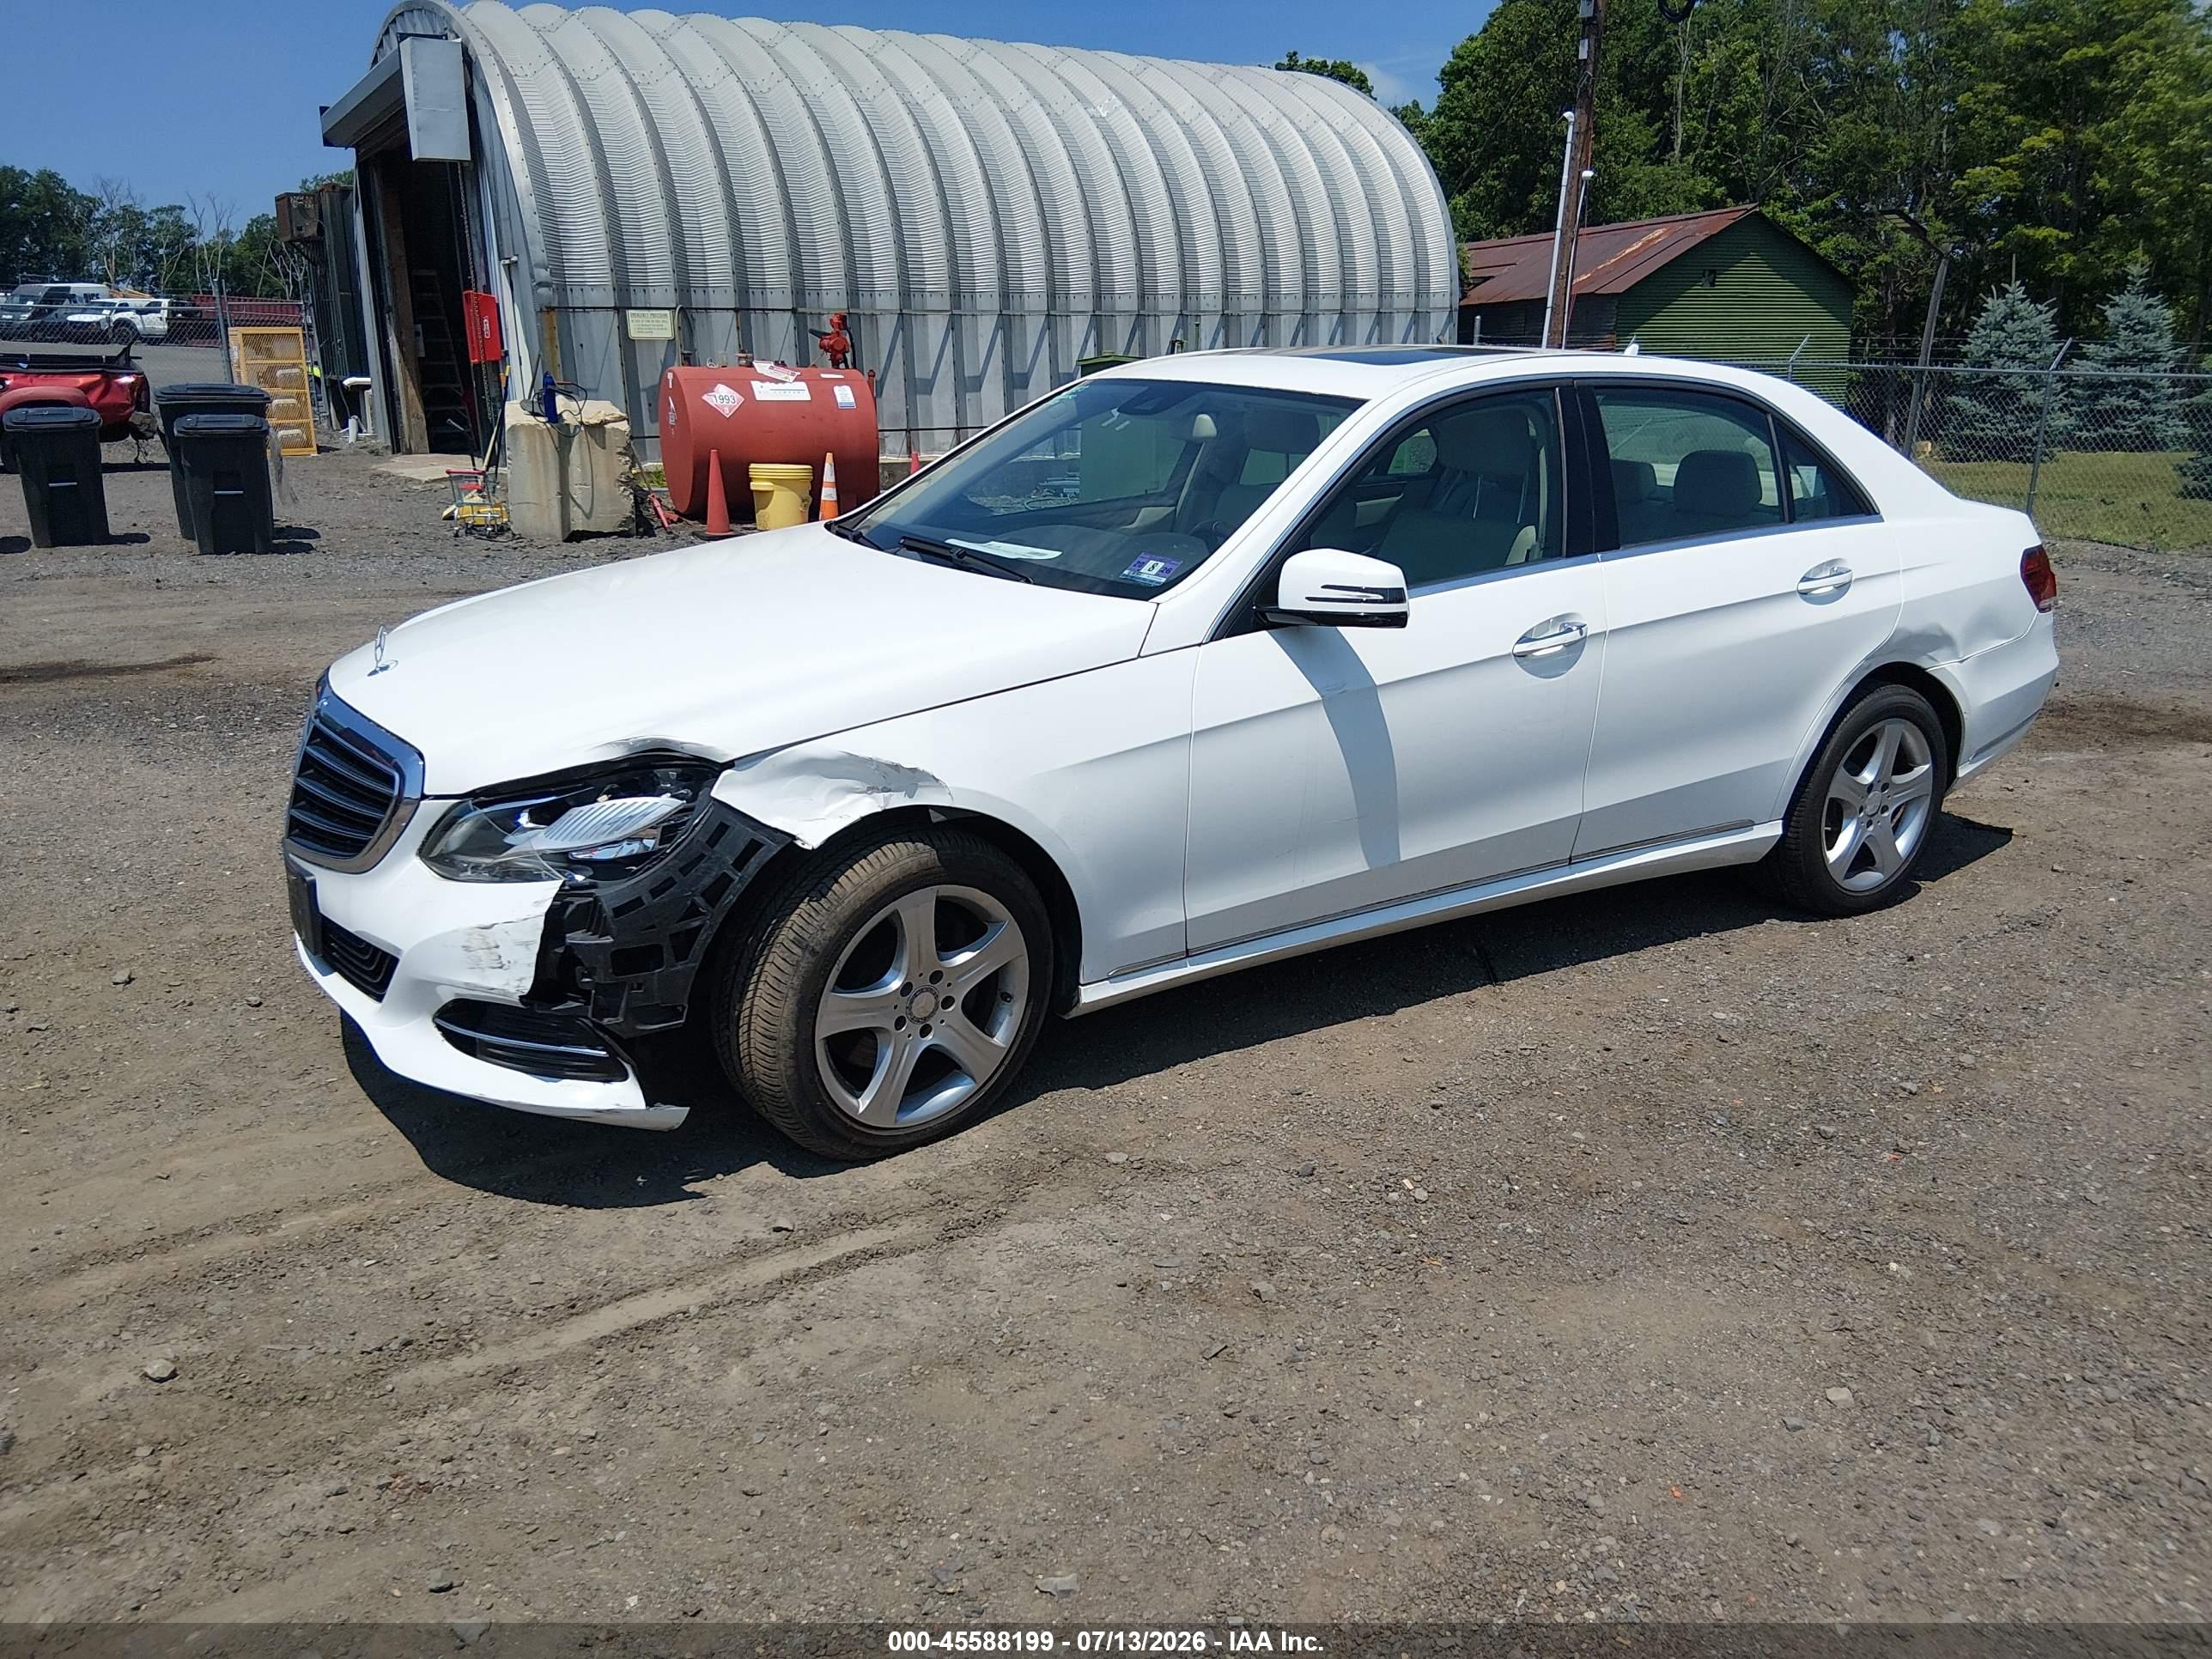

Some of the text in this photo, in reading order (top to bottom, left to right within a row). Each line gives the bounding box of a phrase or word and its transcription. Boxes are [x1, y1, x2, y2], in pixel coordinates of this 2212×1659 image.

[714, 394, 736, 404] 1993
[1147, 562, 1158, 572] 8
[1160, 566, 1173, 574] 26
